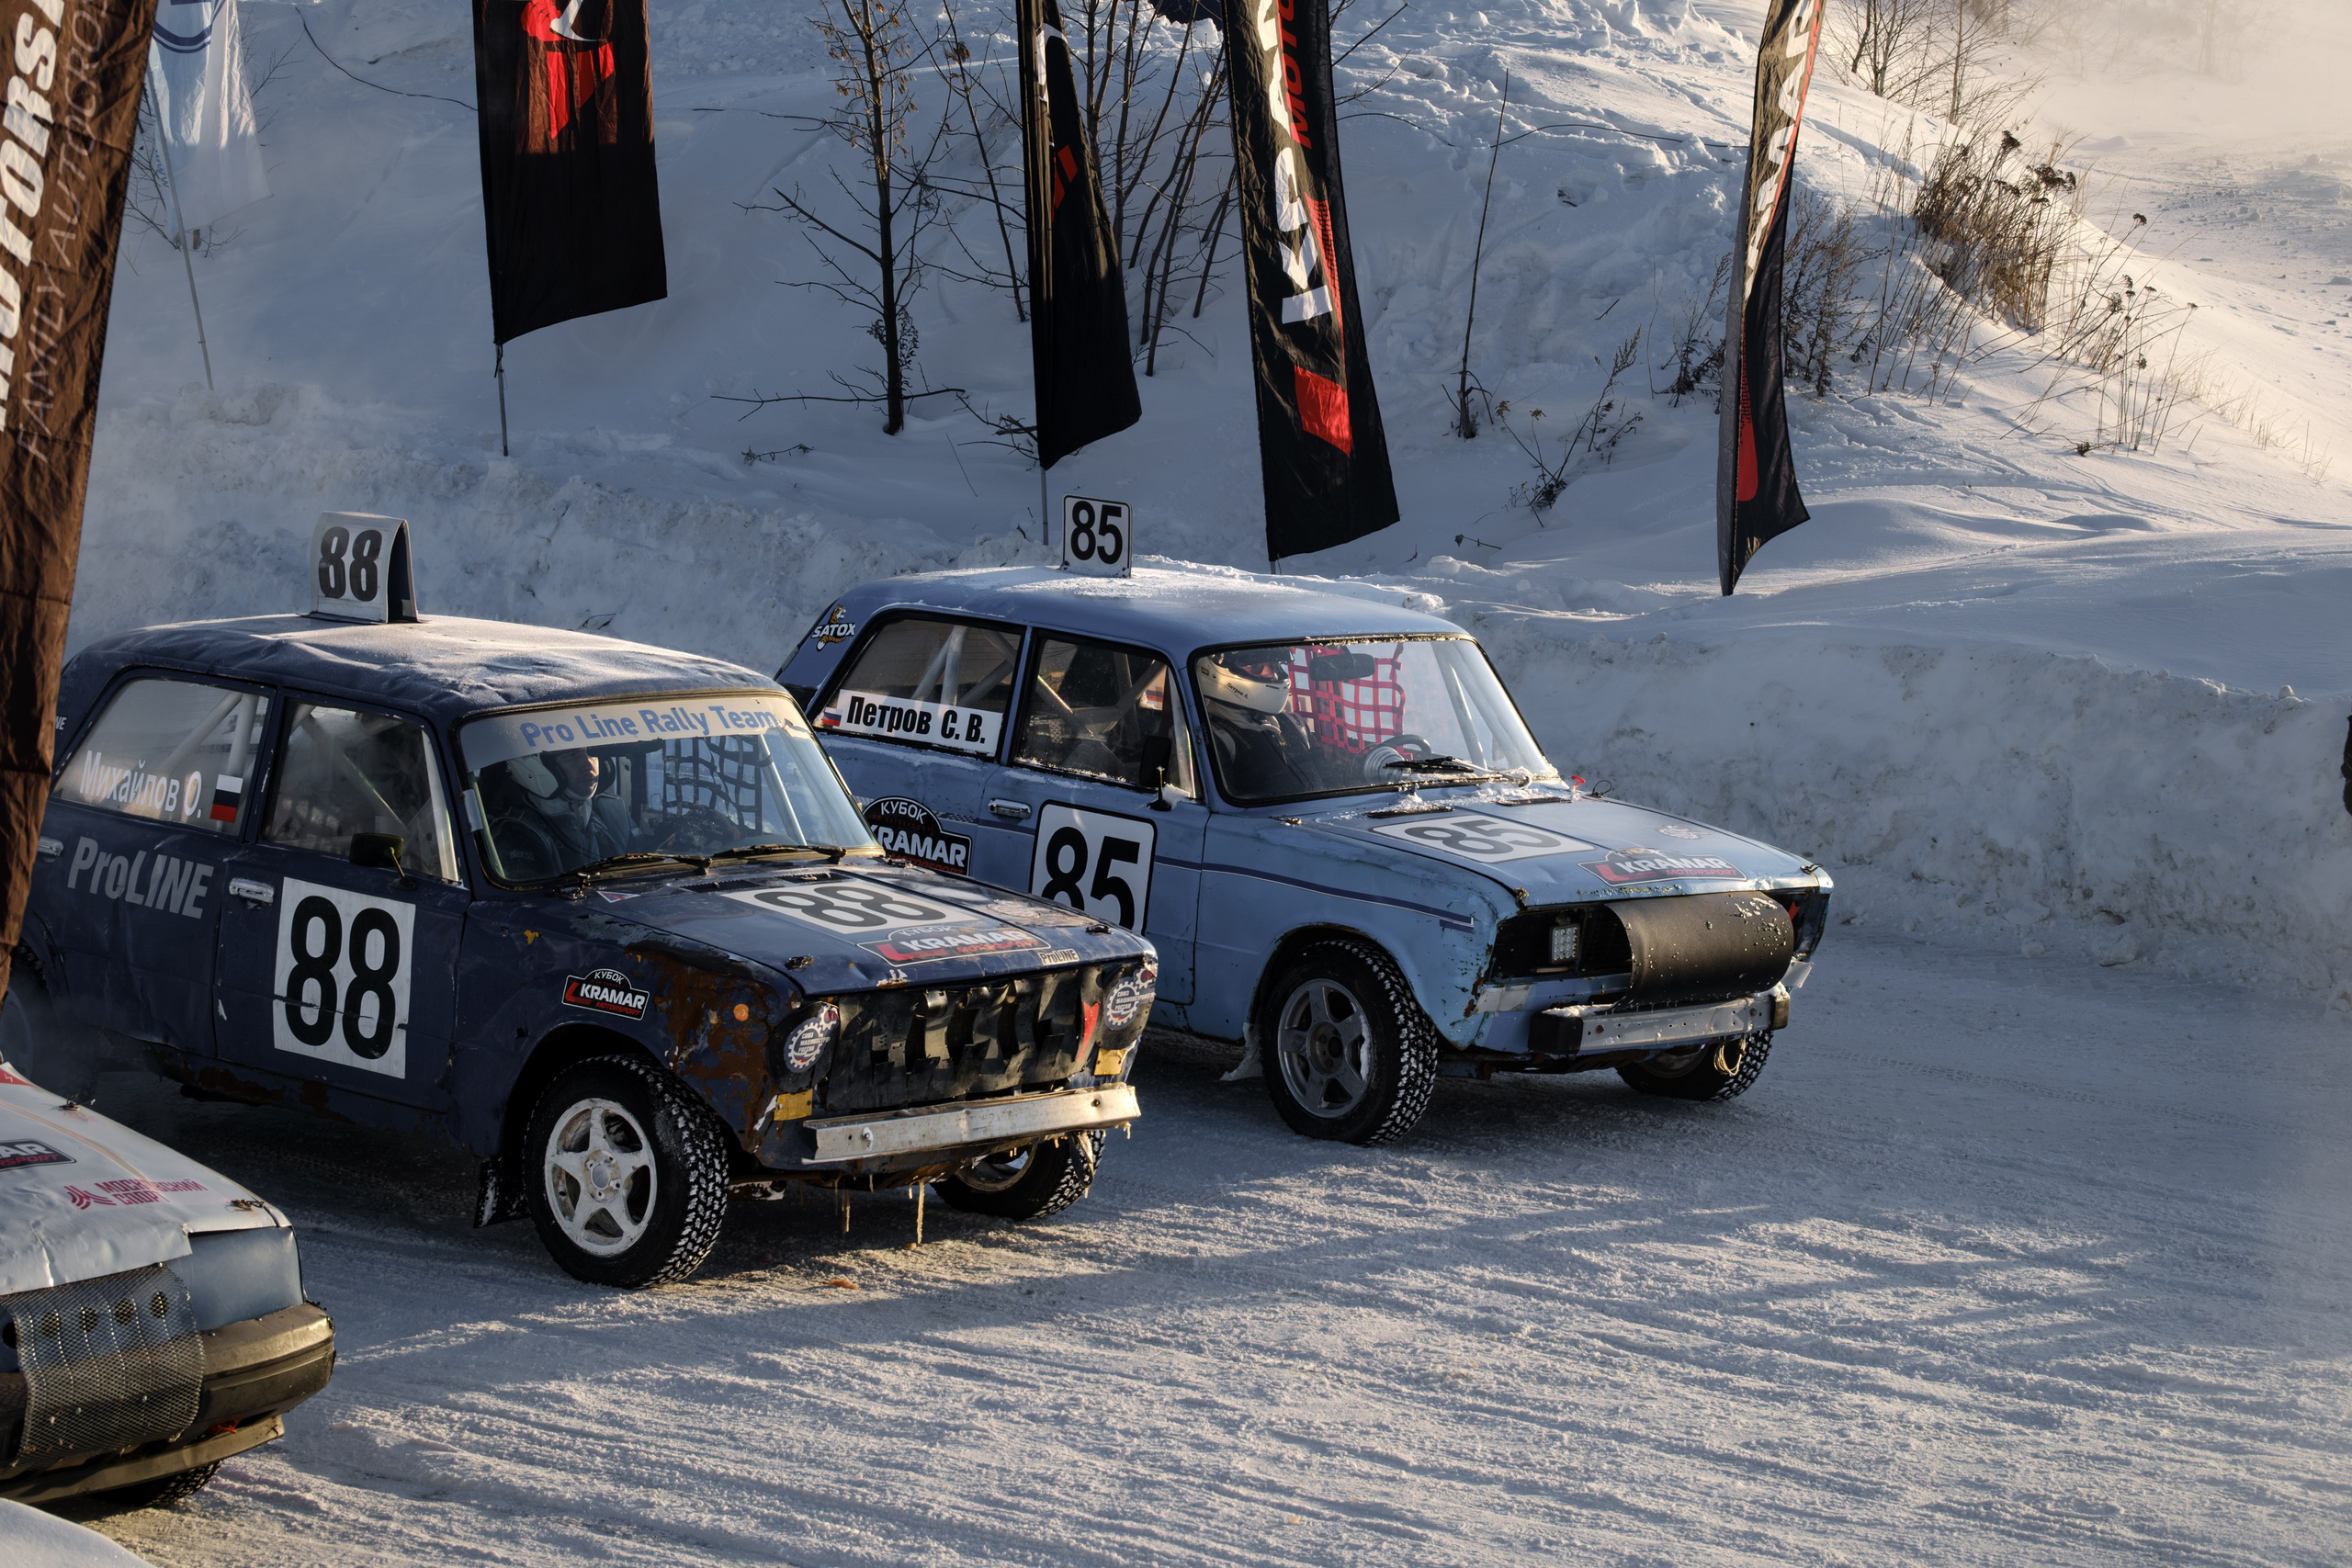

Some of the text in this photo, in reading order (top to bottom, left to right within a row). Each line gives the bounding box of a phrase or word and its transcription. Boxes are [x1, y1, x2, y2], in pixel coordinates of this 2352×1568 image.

[0, 0, 64, 432] OTORS
[17, 0, 111, 462] FAMILY AUTOCRO
[1070, 500, 1123, 565] 85
[318, 526, 382, 602] 88
[811, 623, 856, 638] SATOX
[520, 705, 778, 747] Pro Line Rally Team
[846, 695, 986, 744] Петров С. В.
[80, 750, 202, 818] Михайлов О.
[881, 801, 927, 825] КУБОК
[1405, 819, 1562, 854] 85
[67, 837, 214, 919] ProLINE
[1041, 827, 1140, 931] 85
[1615, 858, 1734, 874] KRAMAR
[754, 886, 946, 928] 88
[900, 929, 1029, 952] KRAMAR
[1040, 950, 1079, 965] ProLINE
[285, 896, 401, 1060] 88
[580, 983, 646, 1009] KRAMAR
[594, 971, 625, 985] КУБОК
[594, 1001, 642, 1016] MOTORSPORT
